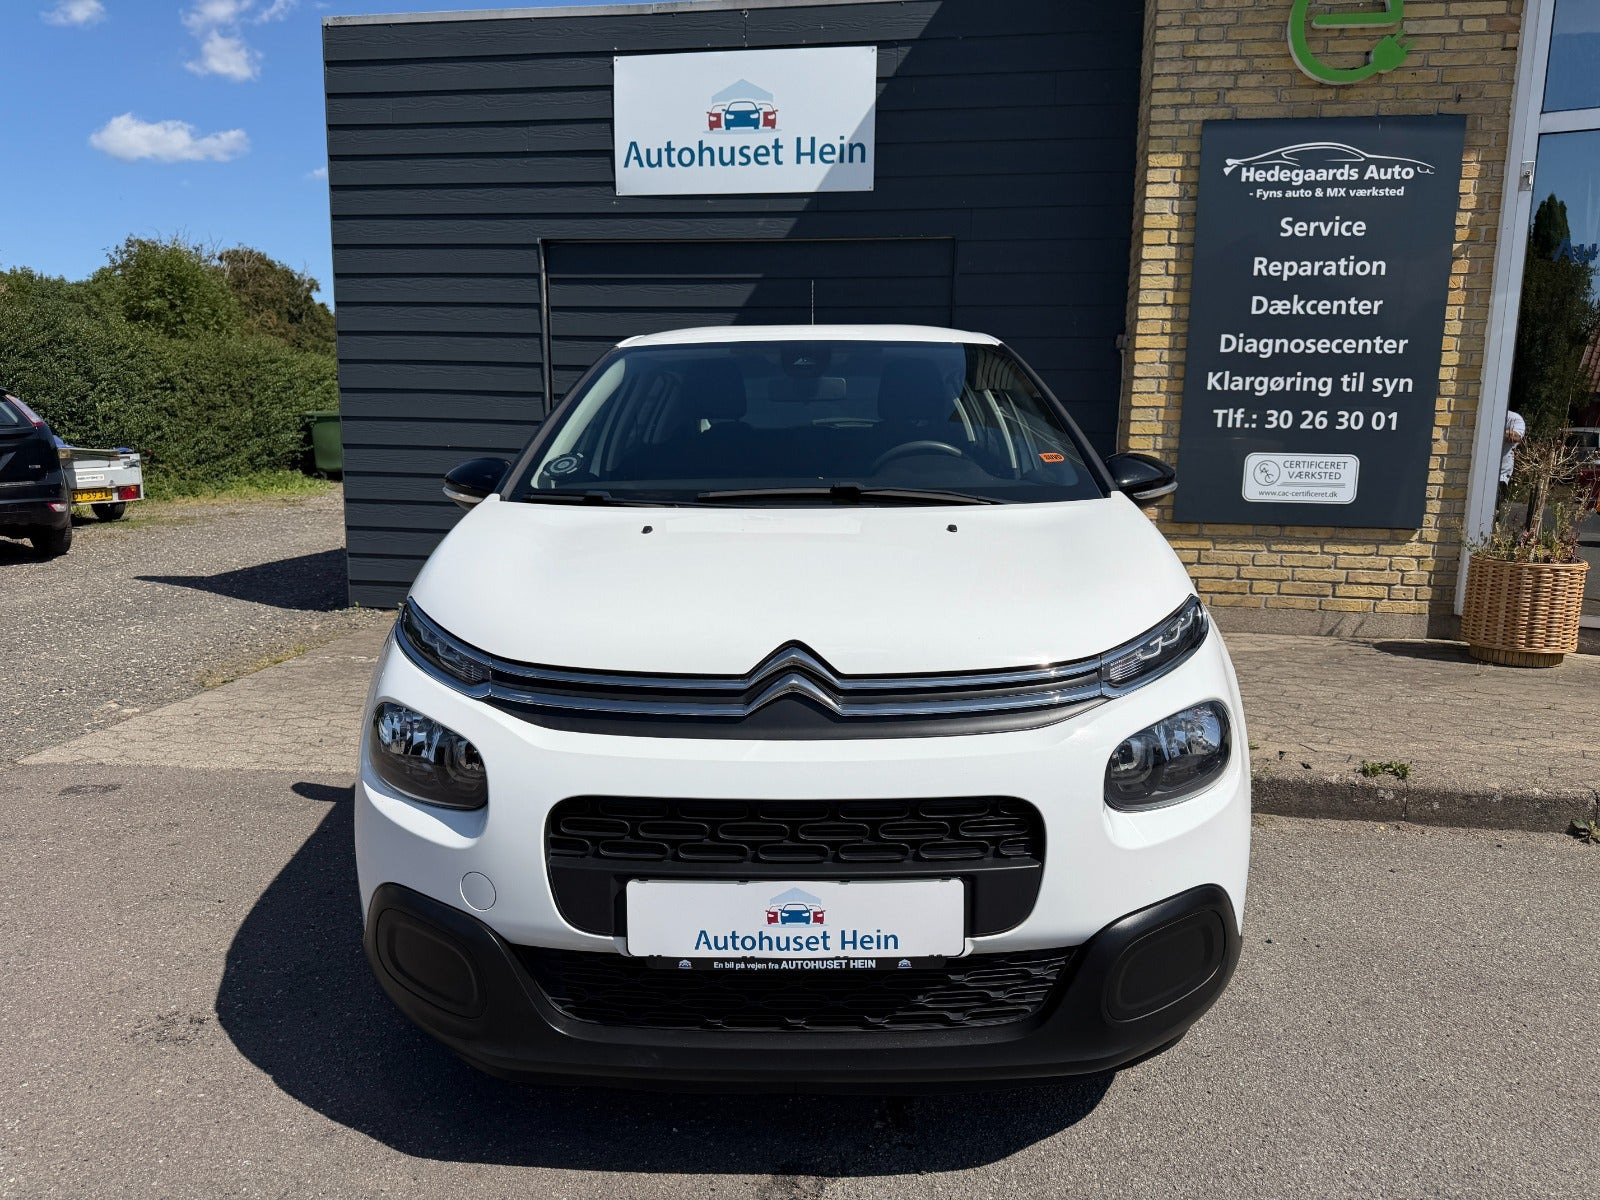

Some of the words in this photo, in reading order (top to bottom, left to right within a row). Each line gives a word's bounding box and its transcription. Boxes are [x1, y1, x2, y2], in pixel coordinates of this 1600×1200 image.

[623, 137, 784, 169] Autohuset
[795, 135, 866, 165] Hein
[1240, 164, 1359, 185] Hedegaards
[1363, 164, 1415, 181] Auto
[1256, 187, 1283, 200] Fyns
[1284, 188, 1312, 198] auto
[1314, 187, 1324, 198] &
[1326, 187, 1346, 198] MX
[1349, 186, 1405, 197] værksted
[1279, 215, 1367, 237] Service
[1252, 255, 1387, 282] Reparation
[1250, 294, 1384, 316] Dækcenter
[1219, 333, 1409, 359] Diagnosecenter
[1206, 370, 1333, 397] Klargøring
[1340, 371, 1365, 393] til
[1371, 376, 1413, 398] syn
[1212, 408, 1257, 429] Tlf.:
[1264, 409, 1294, 430] 30
[1299, 410, 1328, 430] 26
[1335, 410, 1365, 431] 30
[1371, 411, 1398, 431] 01
[1282, 460, 1349, 470] CERTIFICERET
[1287, 471, 1342, 480] VÆRKSTED
[1258, 489, 1338, 499] www.cac-certificeret.dk
[694, 929, 831, 951] Autohuset
[840, 929, 899, 950] Hein
[713, 961, 724, 970] En
[724, 961, 735, 970] bil
[735, 960, 746, 972] på
[746, 961, 767, 972] vejen
[767, 961, 780, 970] fra
[780, 960, 848, 970] AUTOHUSET
[850, 959, 876, 969] HEIN
